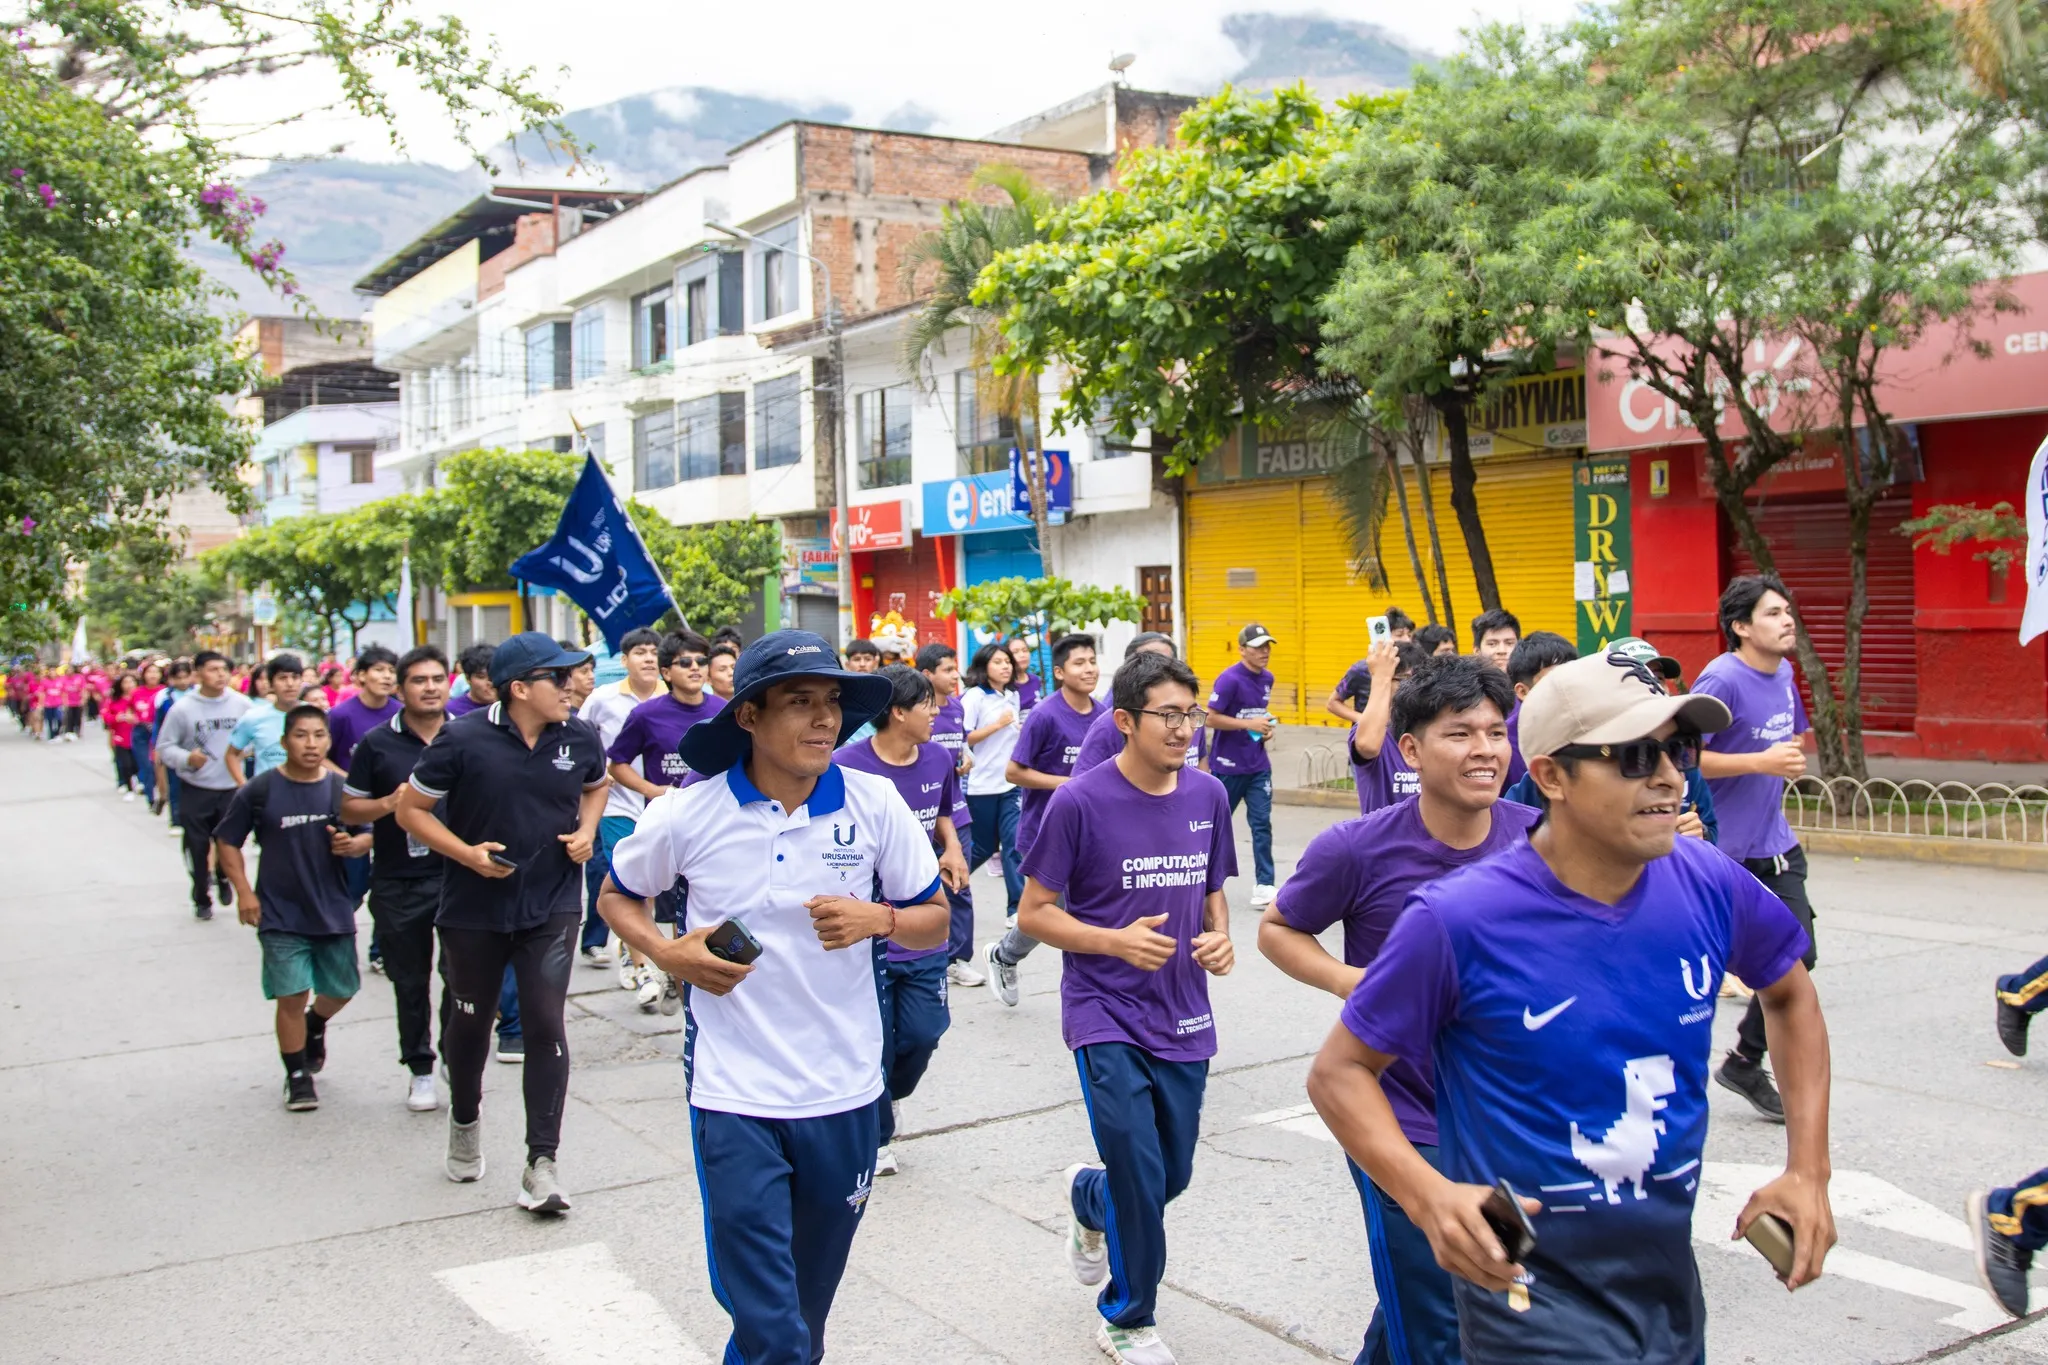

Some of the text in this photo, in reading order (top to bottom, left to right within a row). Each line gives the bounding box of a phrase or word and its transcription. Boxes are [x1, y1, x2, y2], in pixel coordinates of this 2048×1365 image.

[802, 551, 838, 563] FABRI
[1392, 782, 1400, 793] E
[822, 852, 864, 861] URUSAYHUA
[1122, 851, 1208, 873] COMPUTACIÓN
[1122, 875, 1132, 889] E
